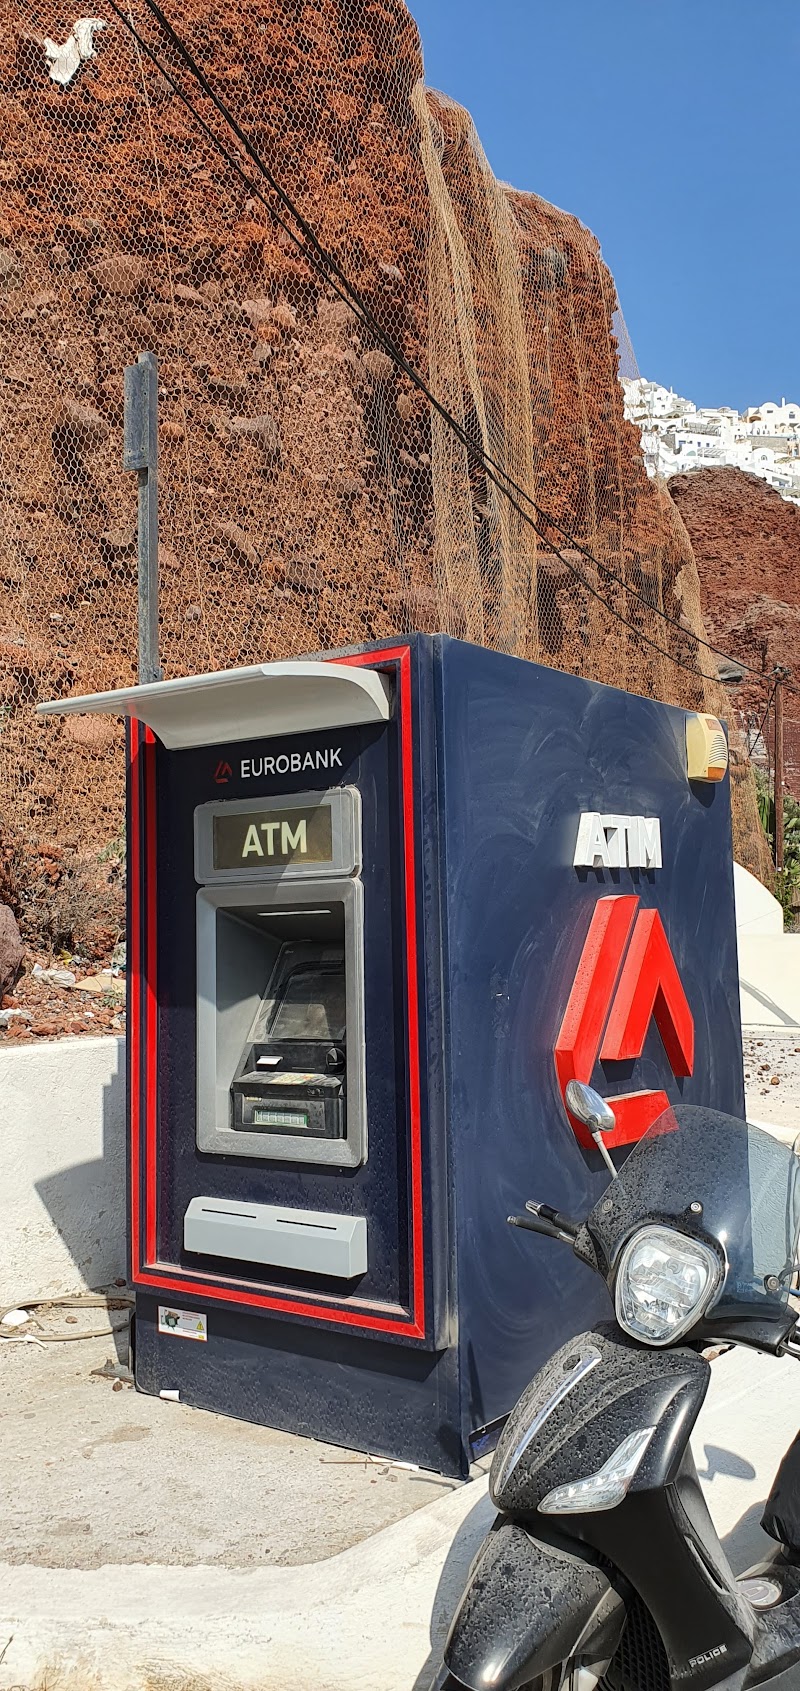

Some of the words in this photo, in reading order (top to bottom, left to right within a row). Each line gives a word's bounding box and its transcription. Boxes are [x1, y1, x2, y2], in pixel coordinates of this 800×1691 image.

[240, 748, 343, 778] EUROBANK
[241, 819, 308, 858] ATM
[573, 812, 663, 868] ATM
[689, 1644, 728, 1668] POLICE
